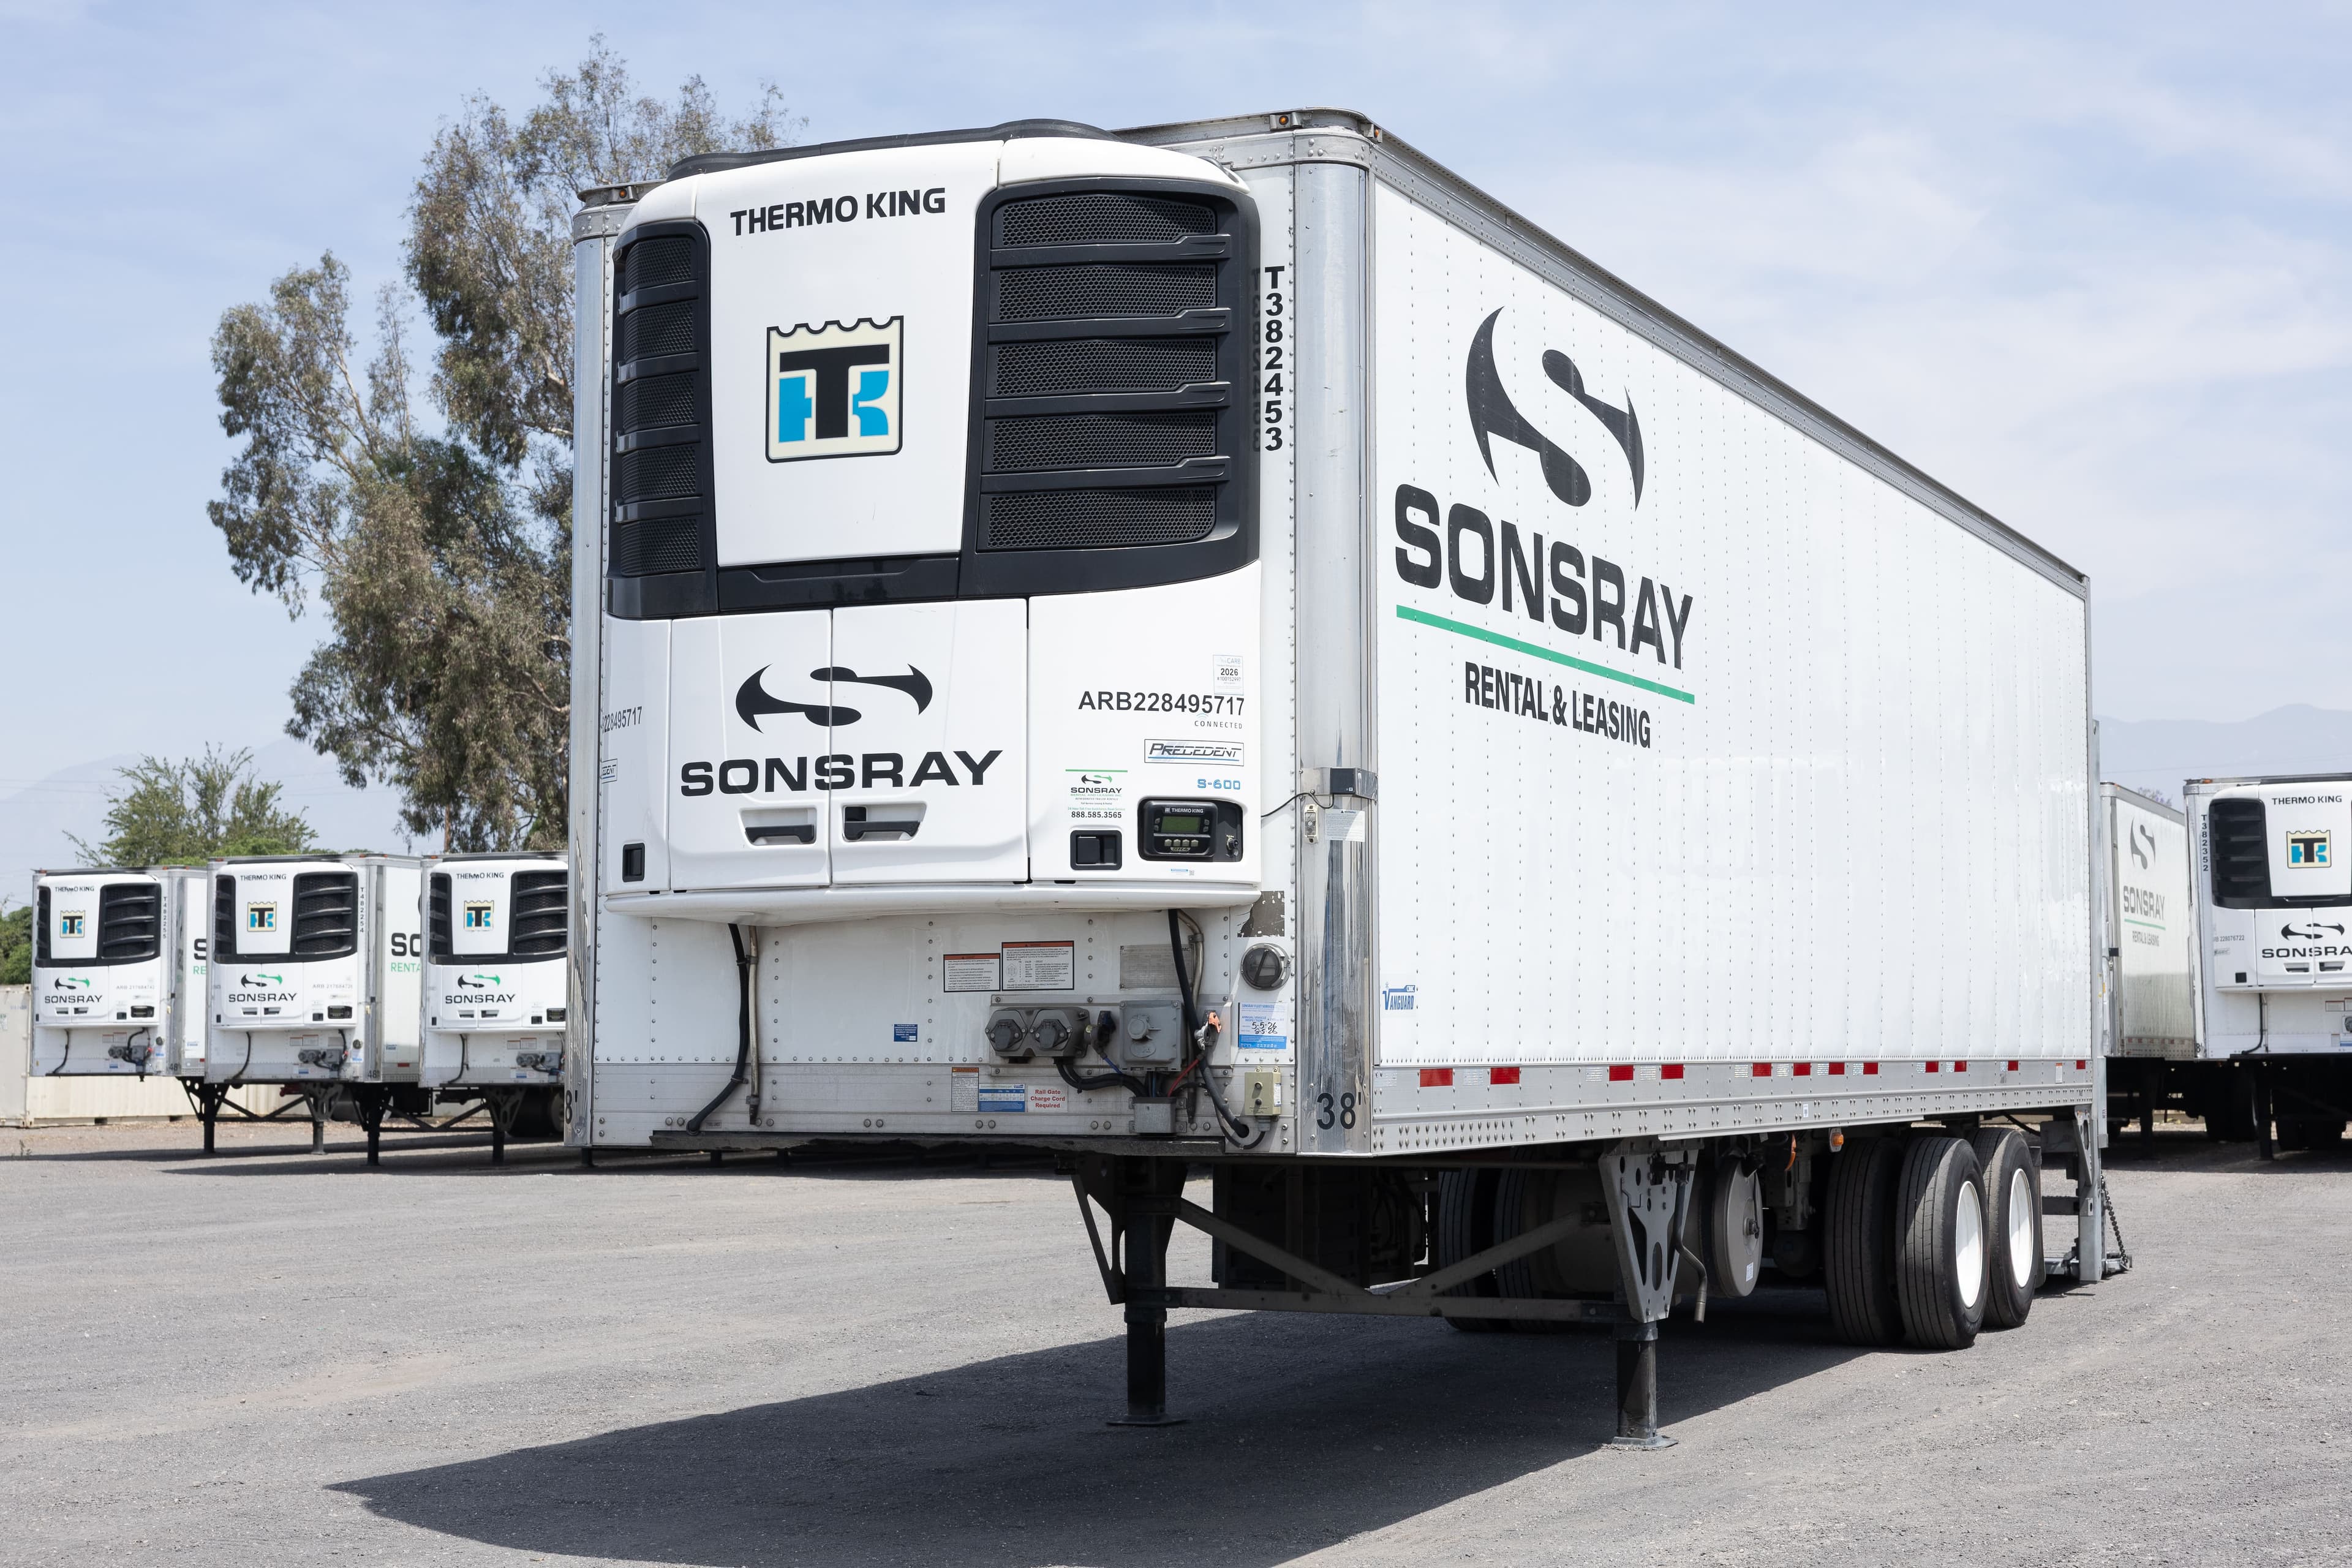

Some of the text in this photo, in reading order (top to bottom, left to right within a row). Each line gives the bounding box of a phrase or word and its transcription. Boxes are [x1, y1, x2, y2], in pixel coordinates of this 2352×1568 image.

[730, 187, 945, 236] THERMO KING
[1264, 266, 1285, 451] T382453
[1395, 484, 1693, 670] SONSRAY
[1220, 668, 1238, 676] 2026
[1078, 690, 1245, 715] ARB228495717
[1465, 661, 1651, 748] RENTAL & LEASING
[1194, 720, 1243, 729] CONNECTED
[680, 750, 1003, 797] SONSRAY
[1197, 778, 1241, 790] S-600
[2272, 796, 2315, 805] THERMO
[2124, 885, 2165, 921] SONSRAY
[45, 995, 102, 1003] SONSRAY
[228, 993, 297, 1002] SONSRAY
[445, 993, 516, 1004] SONSRAY
[1382, 989, 1414, 1010] VANGUARD
